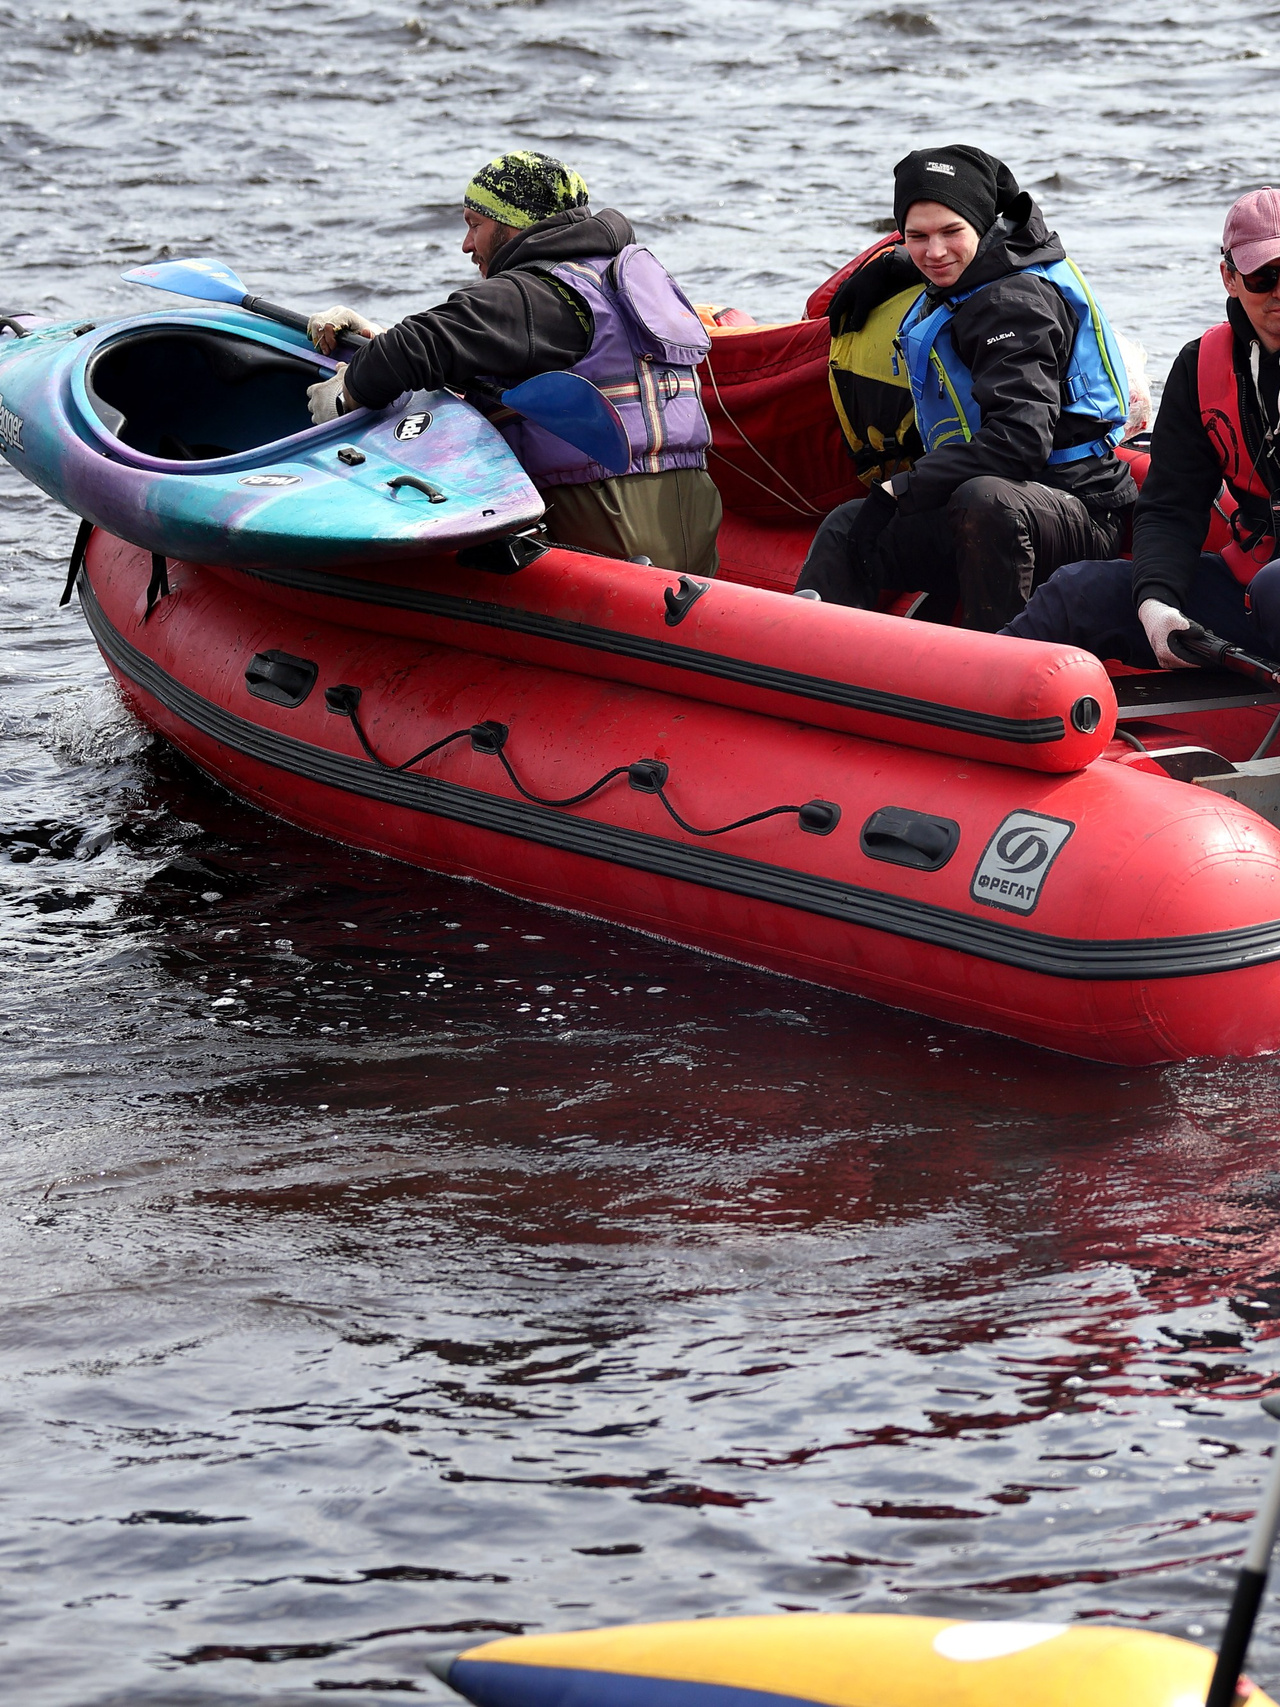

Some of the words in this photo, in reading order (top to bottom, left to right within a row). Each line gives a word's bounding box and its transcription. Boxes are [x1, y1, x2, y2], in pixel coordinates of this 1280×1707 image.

[987, 331, 1016, 345] SALEWA
[0, 393, 25, 448] agger
[400, 411, 426, 441] RPM
[245, 475, 294, 486] RPM
[978, 874, 1036, 901] ФРЕГАТ
